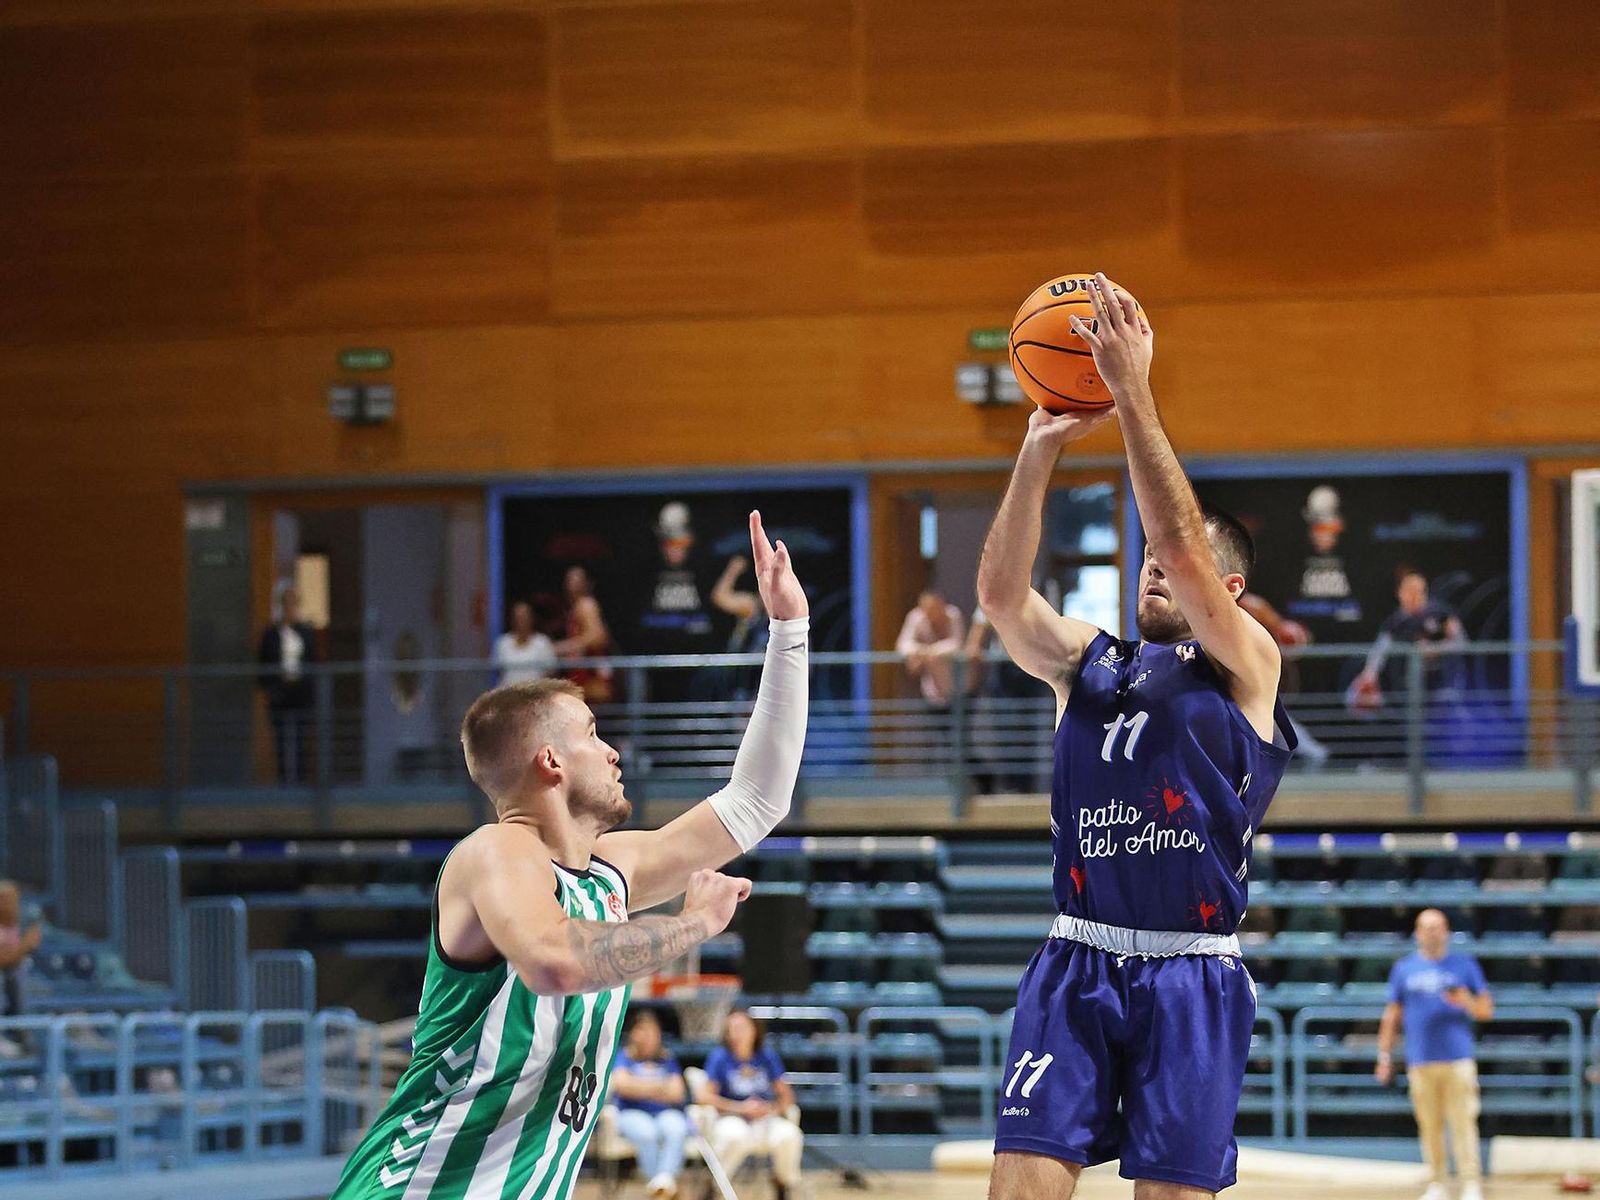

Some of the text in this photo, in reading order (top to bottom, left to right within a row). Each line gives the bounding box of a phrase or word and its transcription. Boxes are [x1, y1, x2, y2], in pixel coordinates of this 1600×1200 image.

[1101, 710, 1150, 763] 11
[1079, 798, 1142, 839] patio
[1080, 821, 1206, 858] del Amor
[1005, 1050, 1054, 1098] 11
